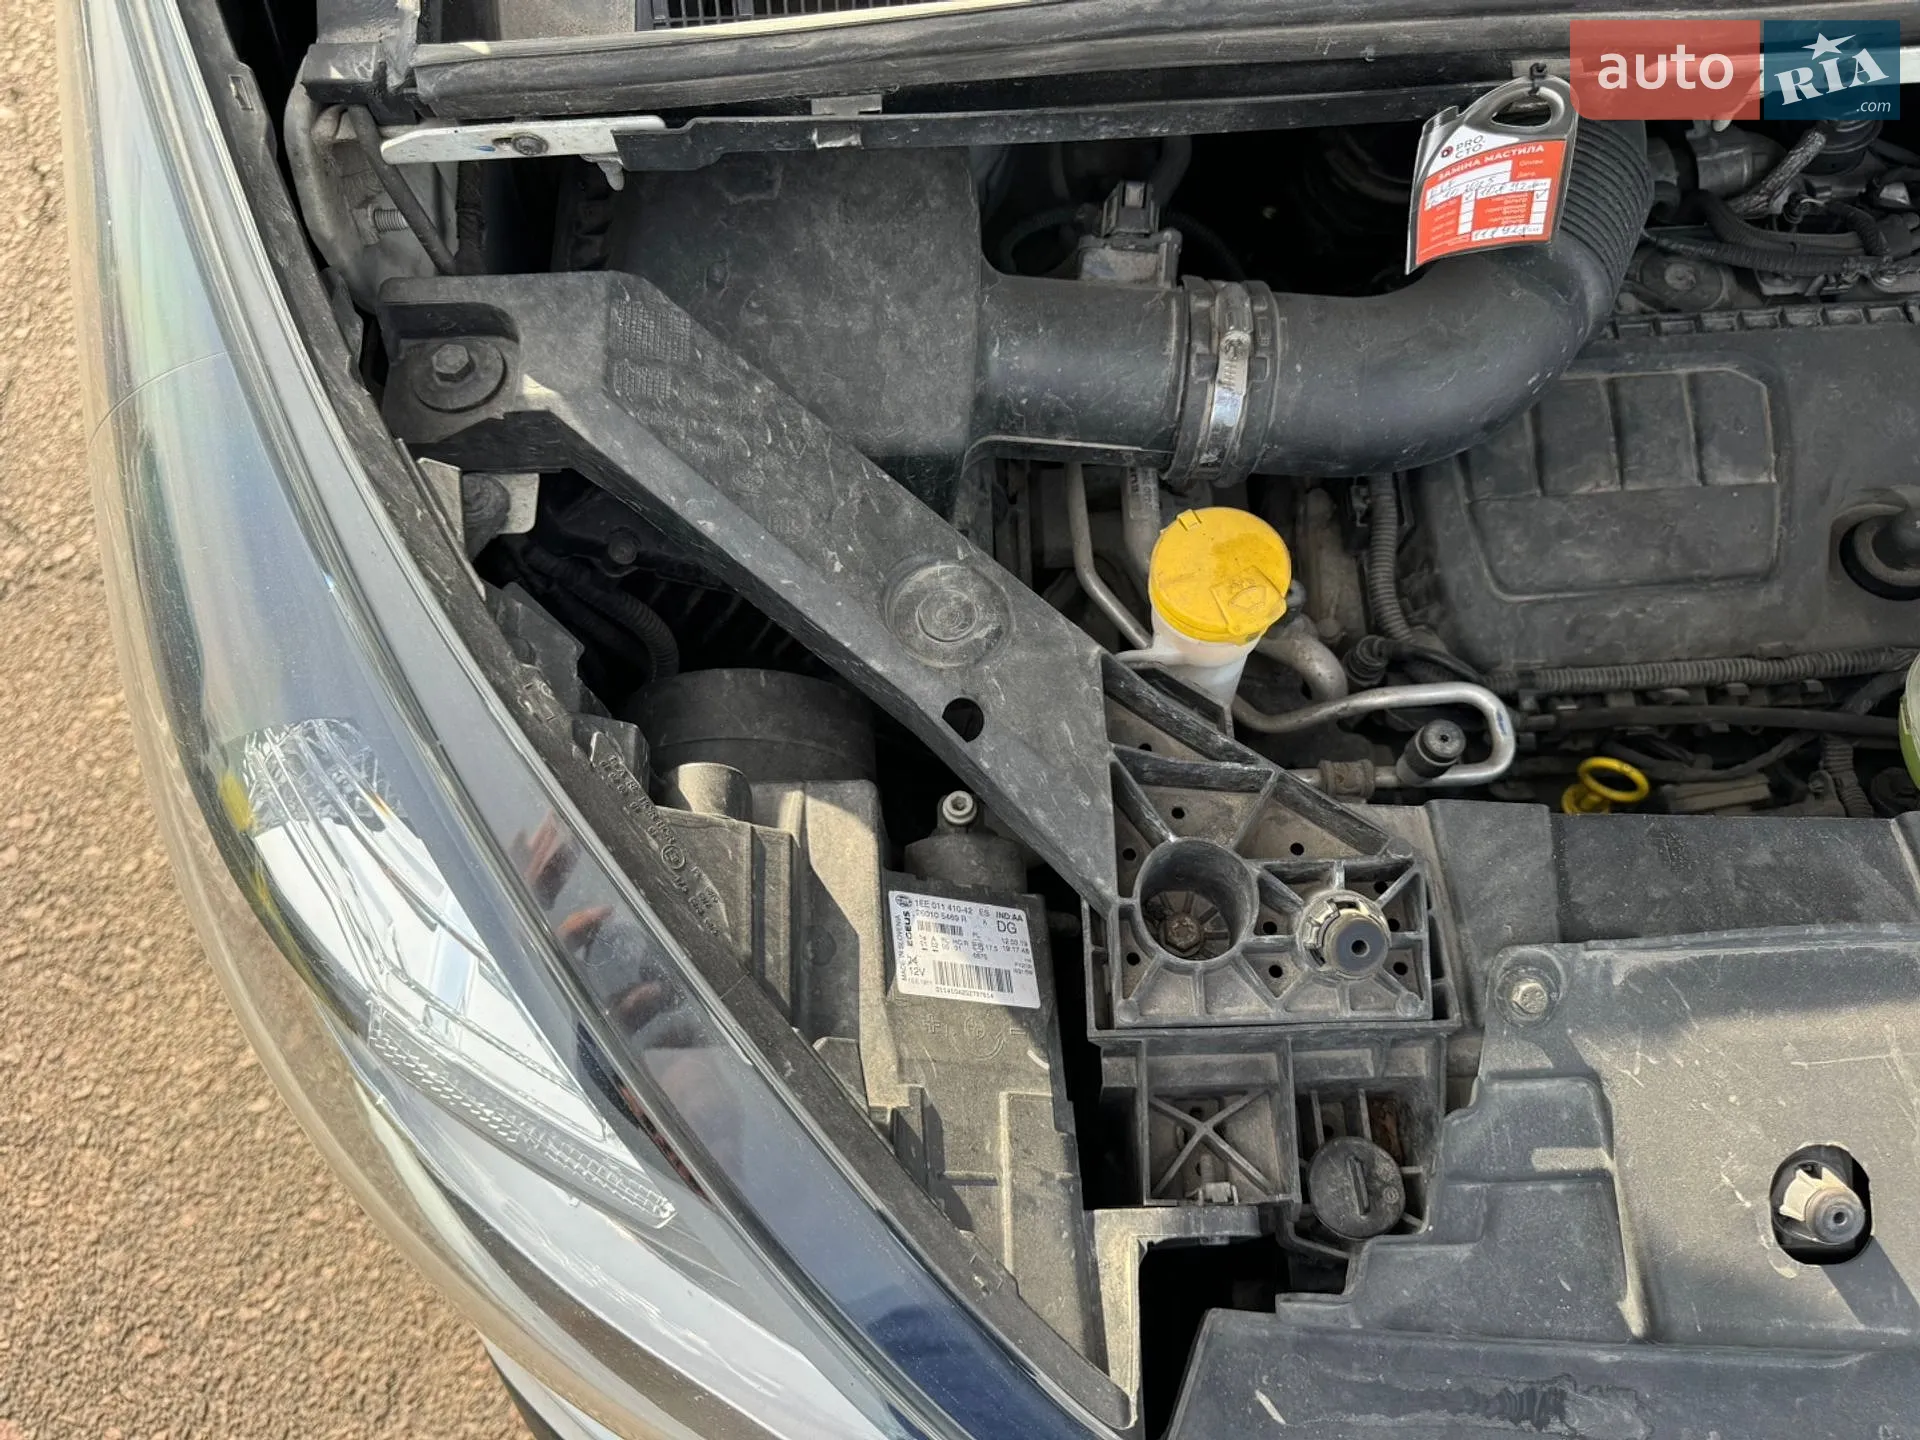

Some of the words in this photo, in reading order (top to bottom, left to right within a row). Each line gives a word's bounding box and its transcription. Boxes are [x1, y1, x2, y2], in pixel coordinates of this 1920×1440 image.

[1437, 160, 1481, 181] ЗАМІНА
[1483, 145, 1545, 164] МАСТИЛА
[997, 920, 1017, 935] DG
[909, 966, 926, 977] 12V
